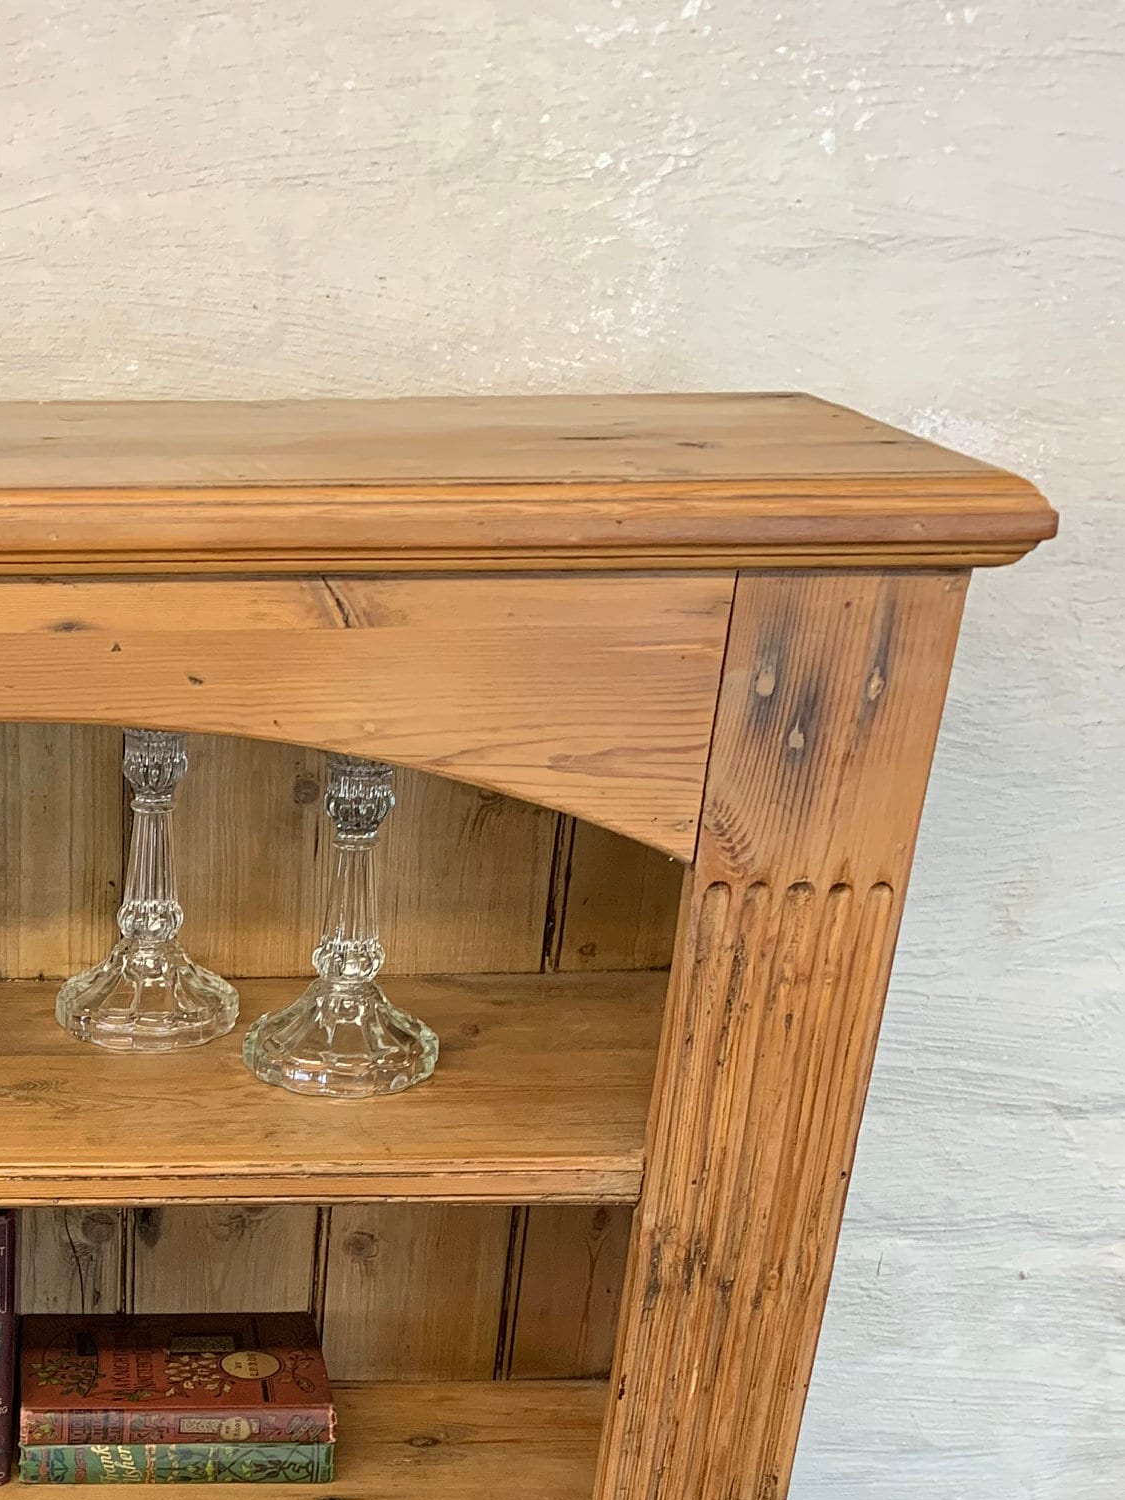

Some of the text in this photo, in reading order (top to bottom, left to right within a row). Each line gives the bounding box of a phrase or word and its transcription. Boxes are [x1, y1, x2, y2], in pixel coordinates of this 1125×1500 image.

[112, 1353, 130, 1383] KNIGHT
[90, 1444, 121, 1483] Frank
[116, 1444, 143, 1483] Usher
